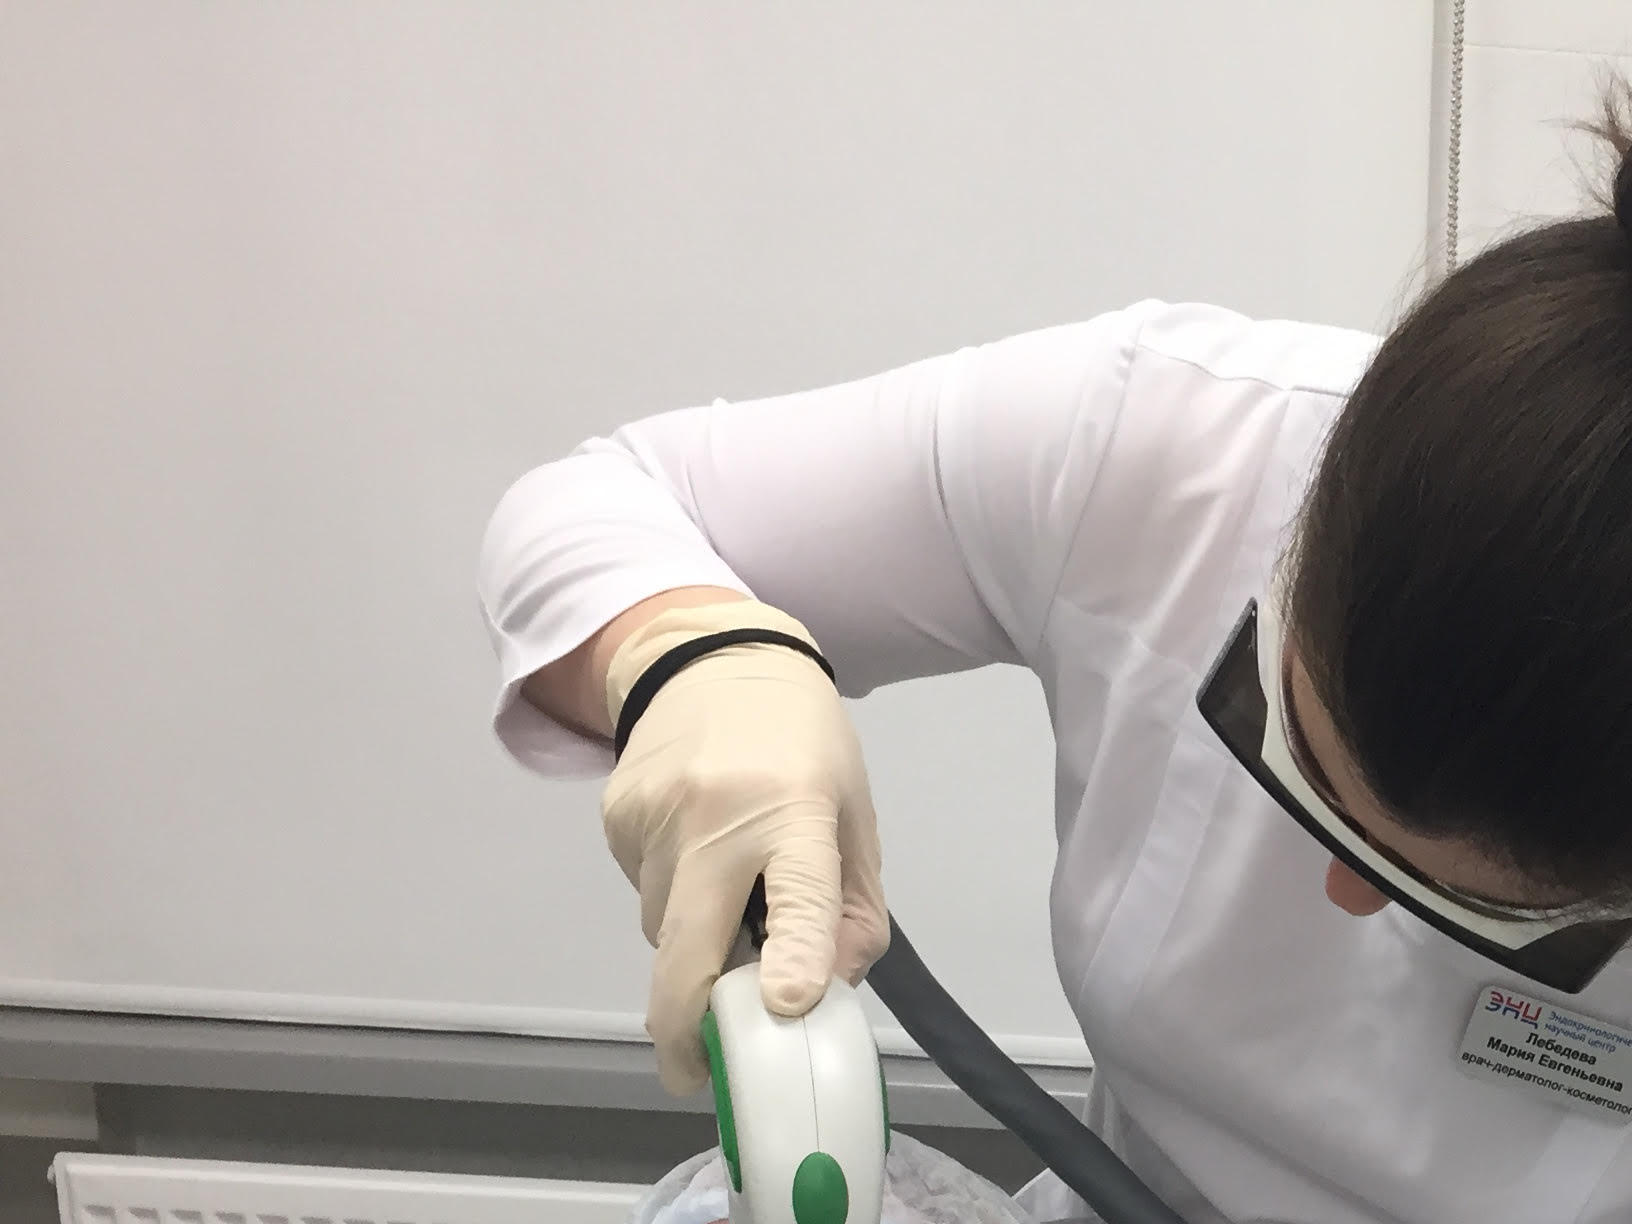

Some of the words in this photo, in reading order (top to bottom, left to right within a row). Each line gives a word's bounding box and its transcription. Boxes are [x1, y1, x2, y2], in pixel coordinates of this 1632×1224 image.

[1485, 990, 1542, 1029] ЭНЦ
[1486, 1036, 1536, 1062] Мария
[1538, 1054, 1624, 1092] Евгеньевна
[1525, 1032, 1597, 1065] Лебедева
